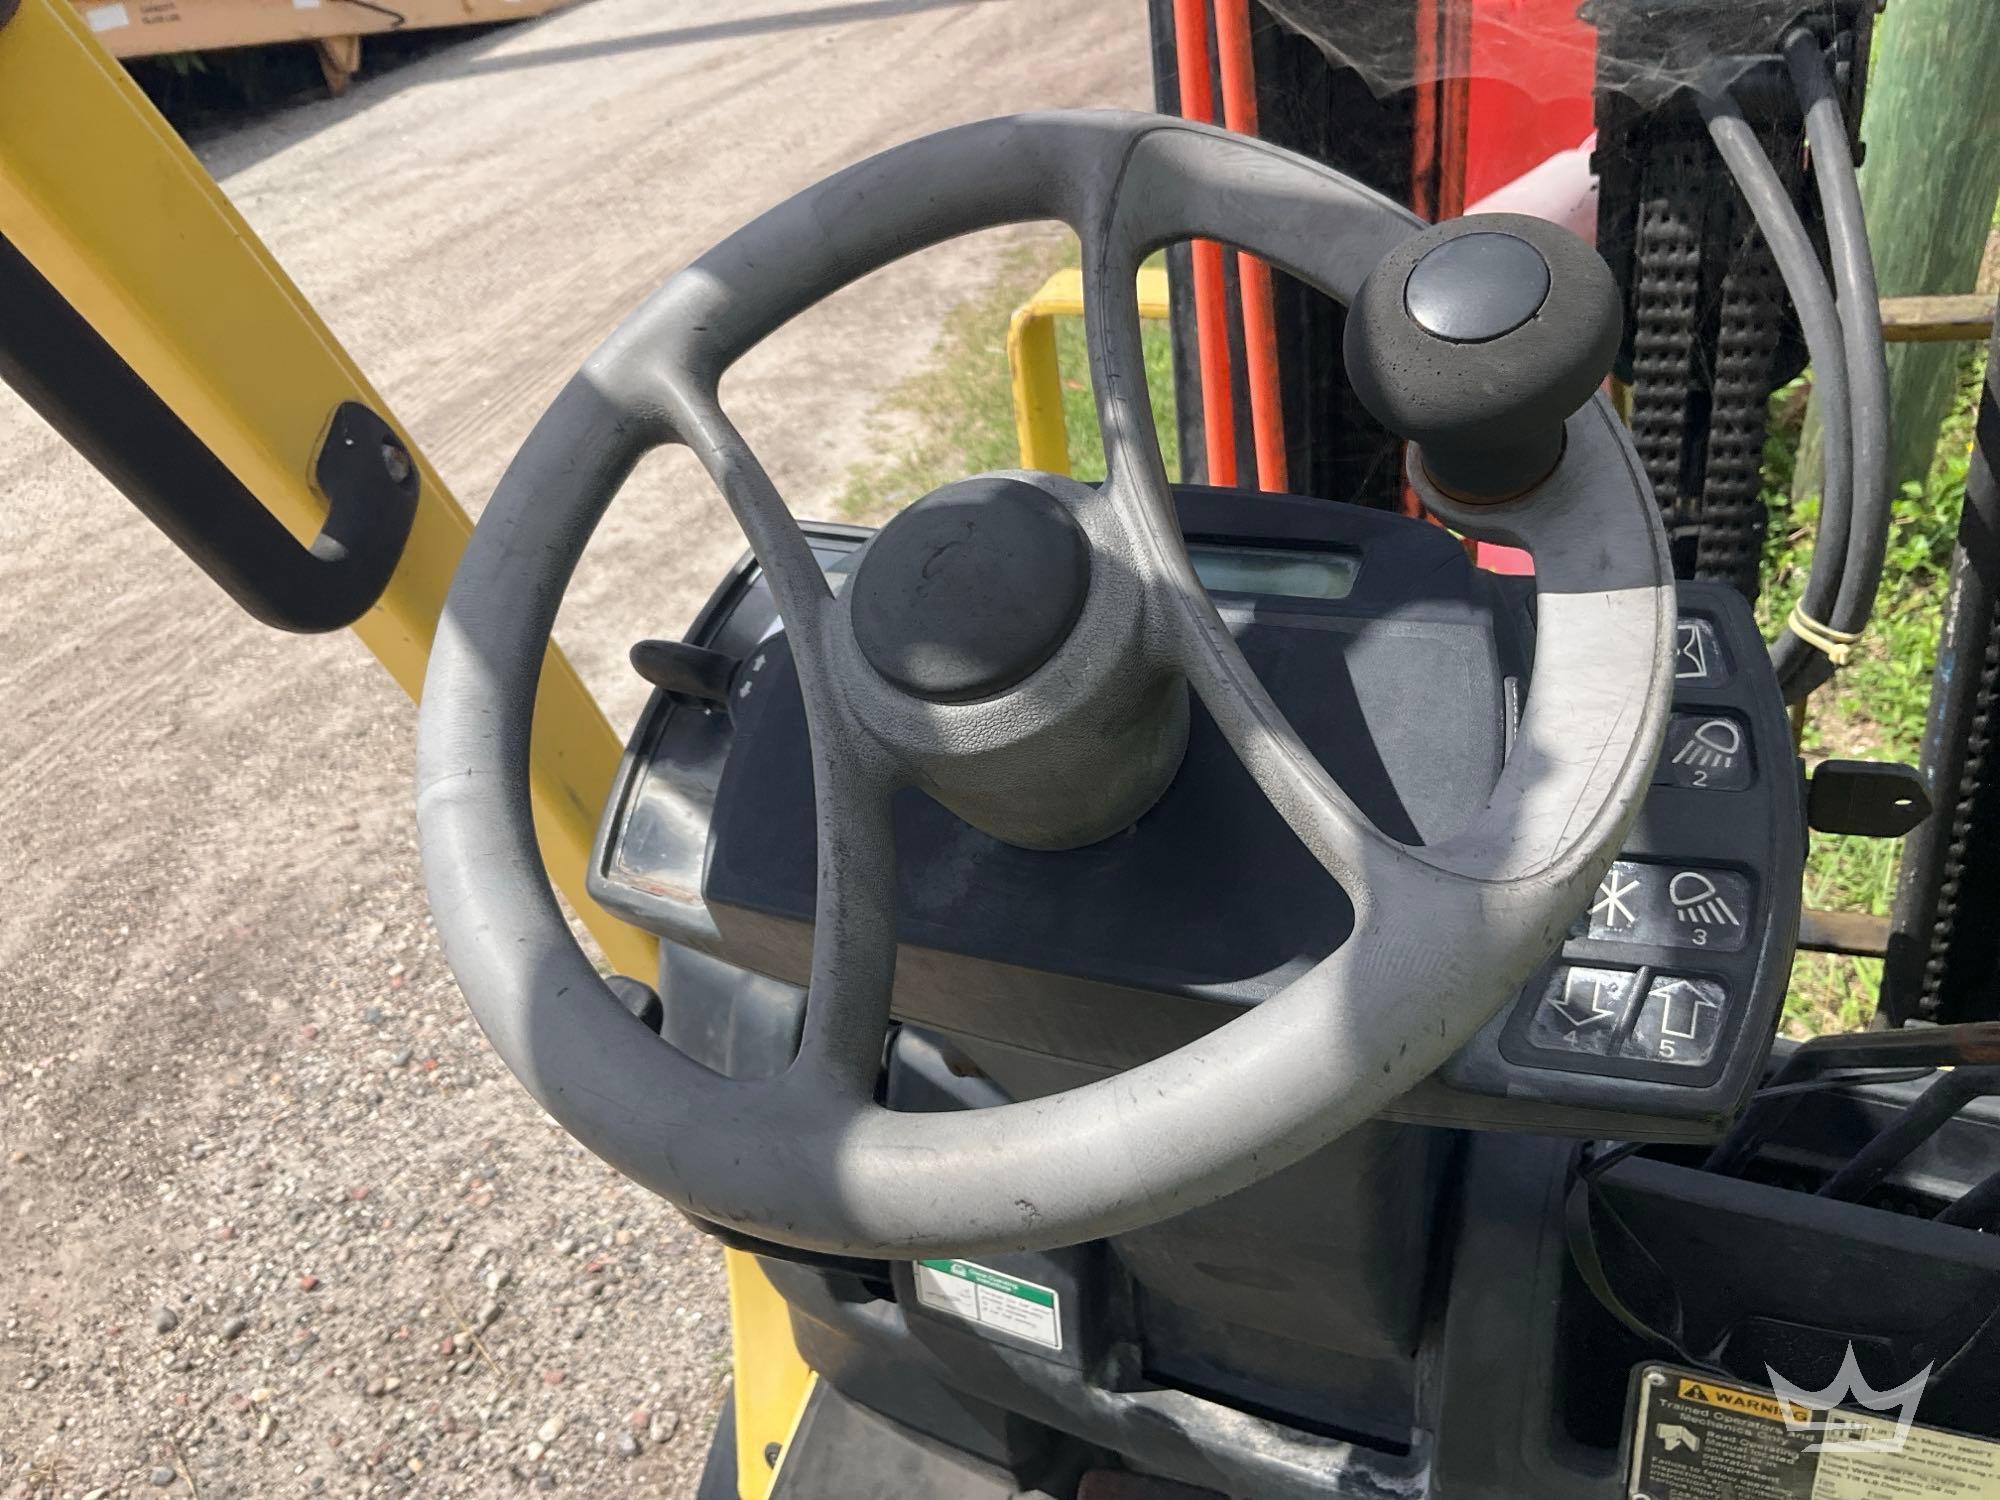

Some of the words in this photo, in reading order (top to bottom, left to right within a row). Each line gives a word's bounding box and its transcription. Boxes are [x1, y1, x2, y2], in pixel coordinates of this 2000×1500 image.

[1692, 770, 1707, 787] 2
[1692, 928, 1707, 945] 3
[1563, 1030, 1578, 1047] 4
[1659, 1039, 1675, 1058] 5
[1659, 1398, 1709, 1417] Trained
[1713, 1411, 1783, 1435] Operators
[1679, 1412, 1752, 1437] Mechanics
[1757, 1431, 1789, 1446] Only
[1705, 1438, 1747, 1453] Manual
[1706, 1430, 1736, 1443] Read
[1739, 1439, 1799, 1461] Operating
